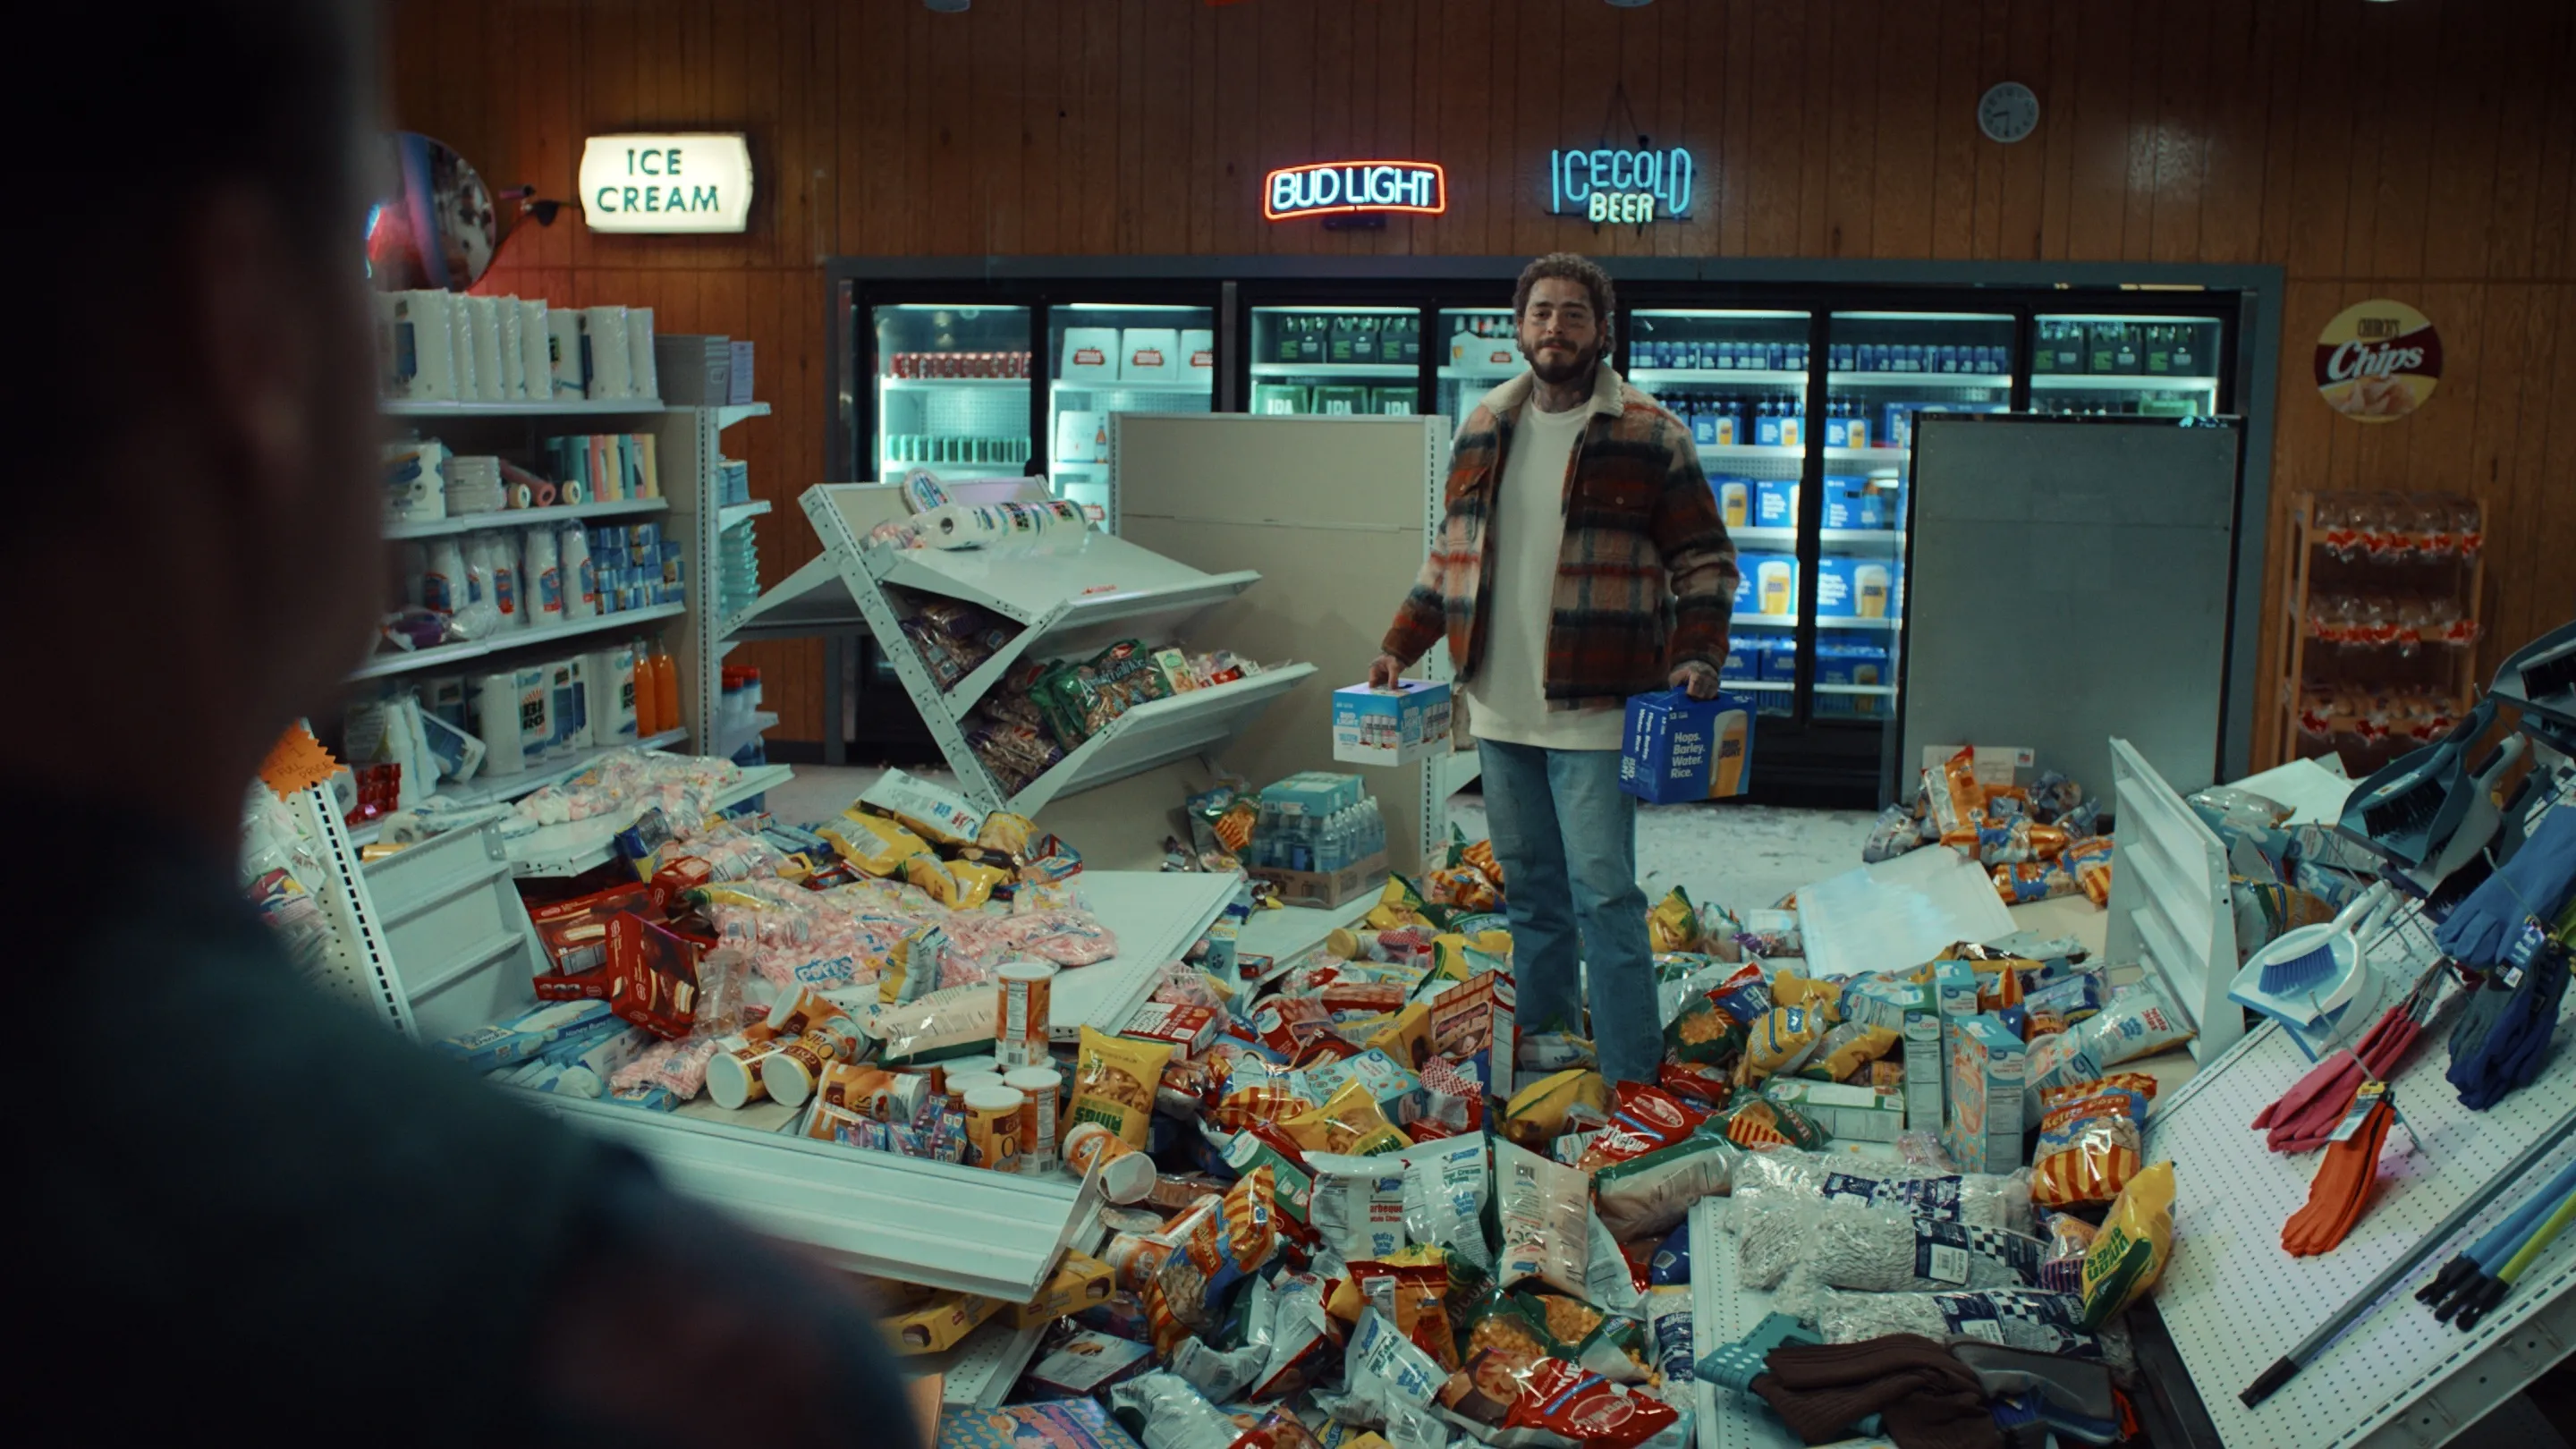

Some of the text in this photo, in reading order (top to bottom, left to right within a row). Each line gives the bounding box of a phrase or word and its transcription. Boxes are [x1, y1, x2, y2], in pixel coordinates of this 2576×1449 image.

[626, 148, 682, 176] ICE
[597, 185, 719, 214] CREAM
[1272, 165, 1435, 211] BUD LIGHT
[1589, 191, 1654, 224] BEER
[2327, 338, 2425, 381] Chips
[1672, 743, 1706, 756] Barley.
[1674, 732, 1701, 744] Hops.
[1669, 767, 1693, 779] Rice.
[1671, 755, 1703, 767] Water.
